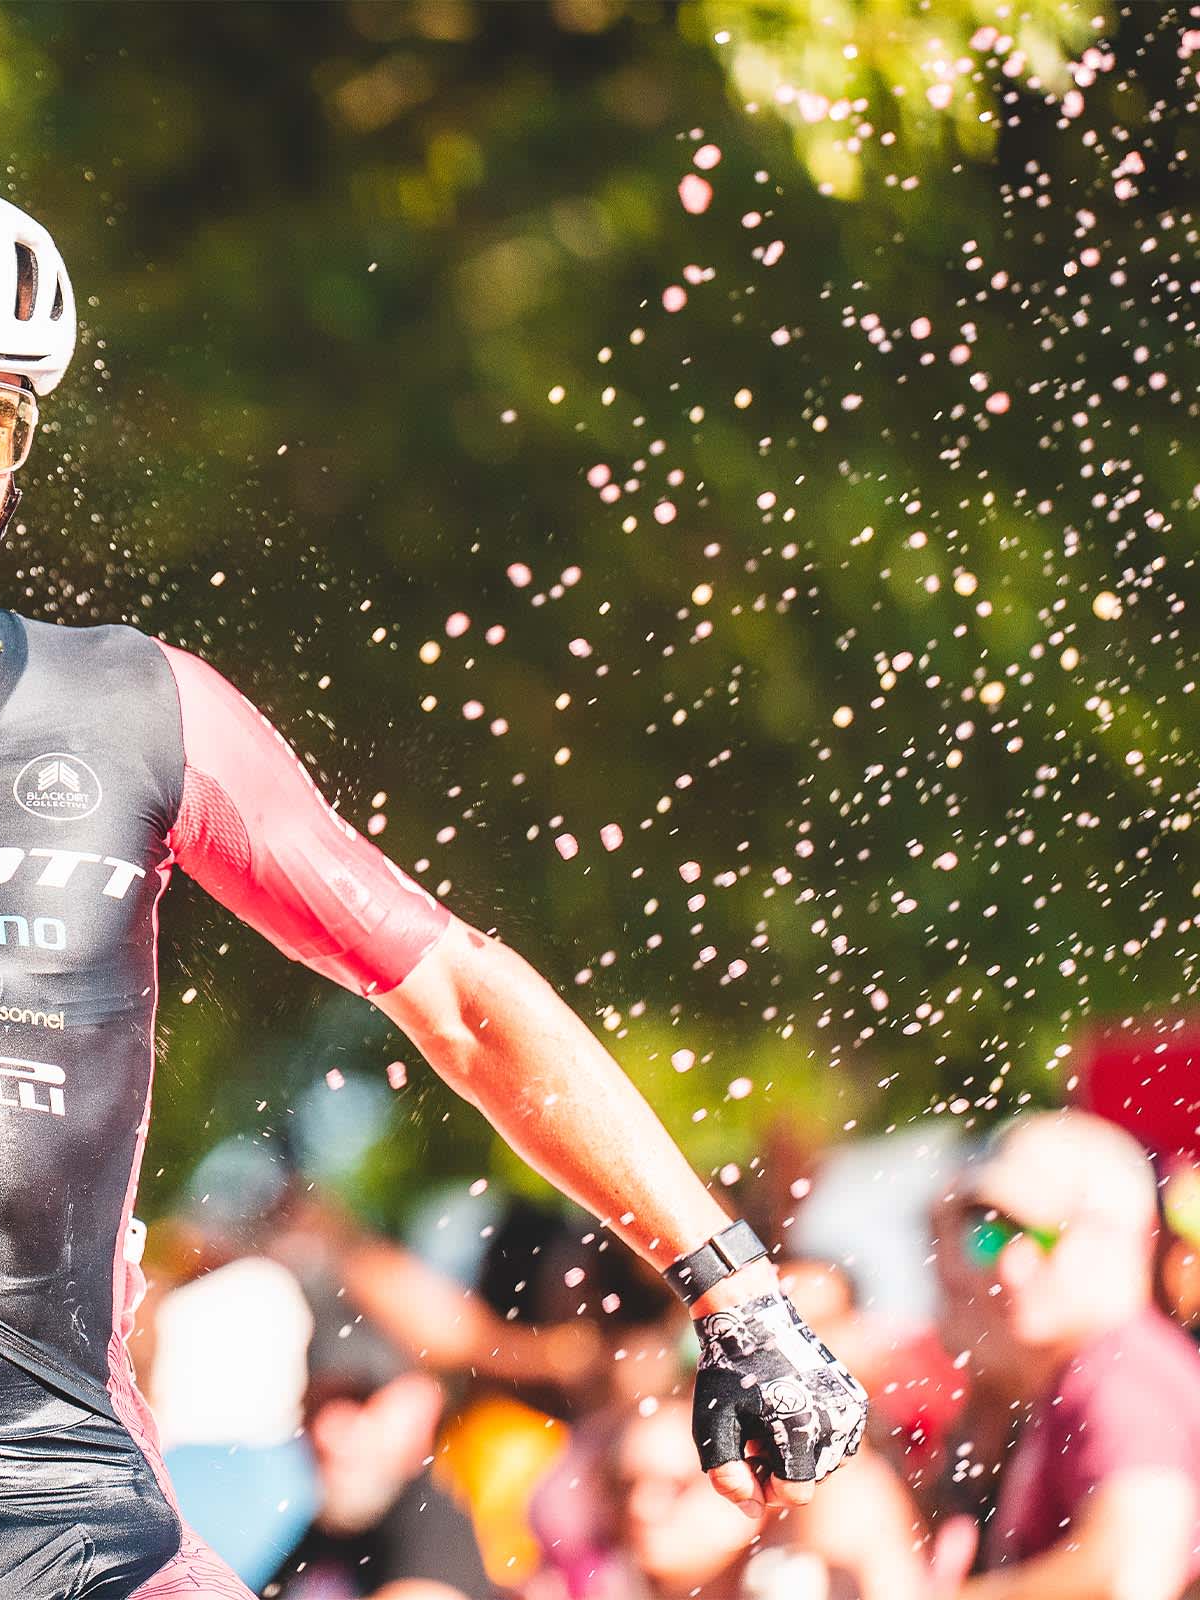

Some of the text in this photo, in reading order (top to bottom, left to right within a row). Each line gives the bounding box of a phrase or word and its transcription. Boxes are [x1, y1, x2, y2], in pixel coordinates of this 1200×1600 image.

[26, 791, 89, 803] BLACK DIRT
[25, 800, 88, 809] COLLECTIVE
